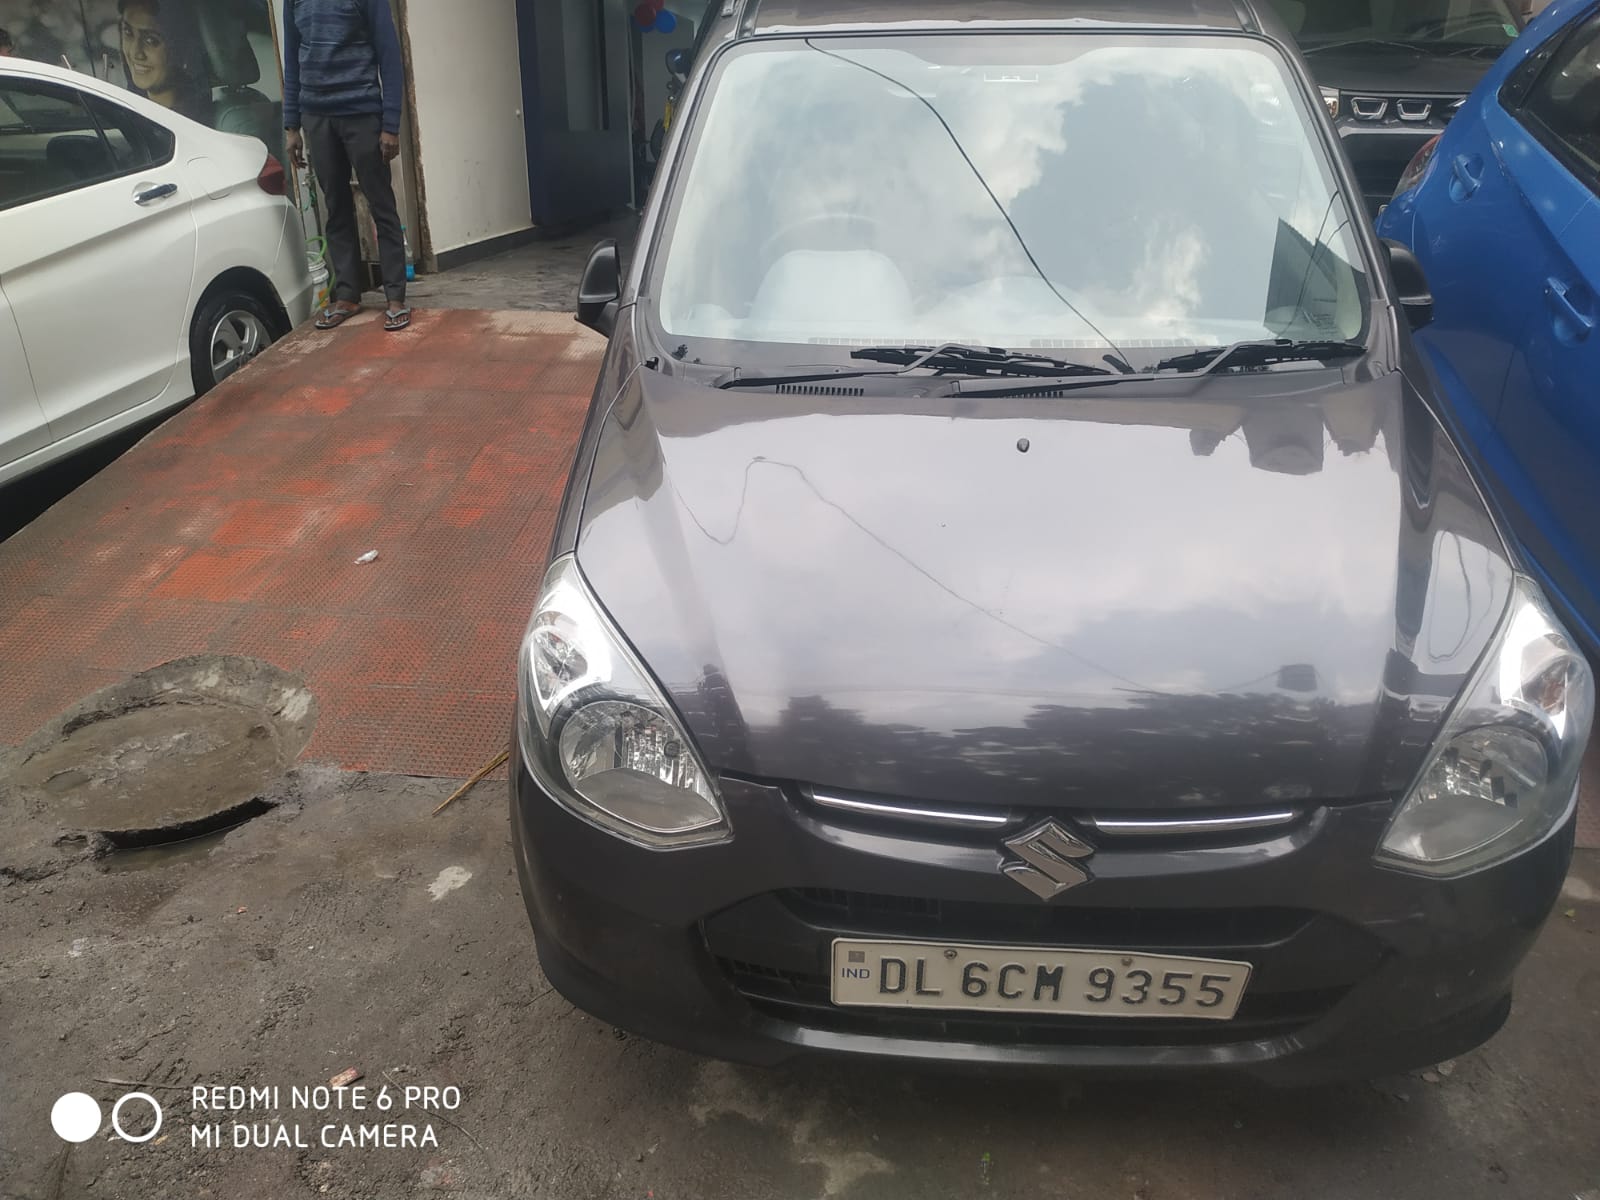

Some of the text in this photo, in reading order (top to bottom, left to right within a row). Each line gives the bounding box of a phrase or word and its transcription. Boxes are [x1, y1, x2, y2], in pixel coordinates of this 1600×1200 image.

[841, 967, 870, 979] IND
[879, 957, 1232, 1008] DL 6CM 9355
